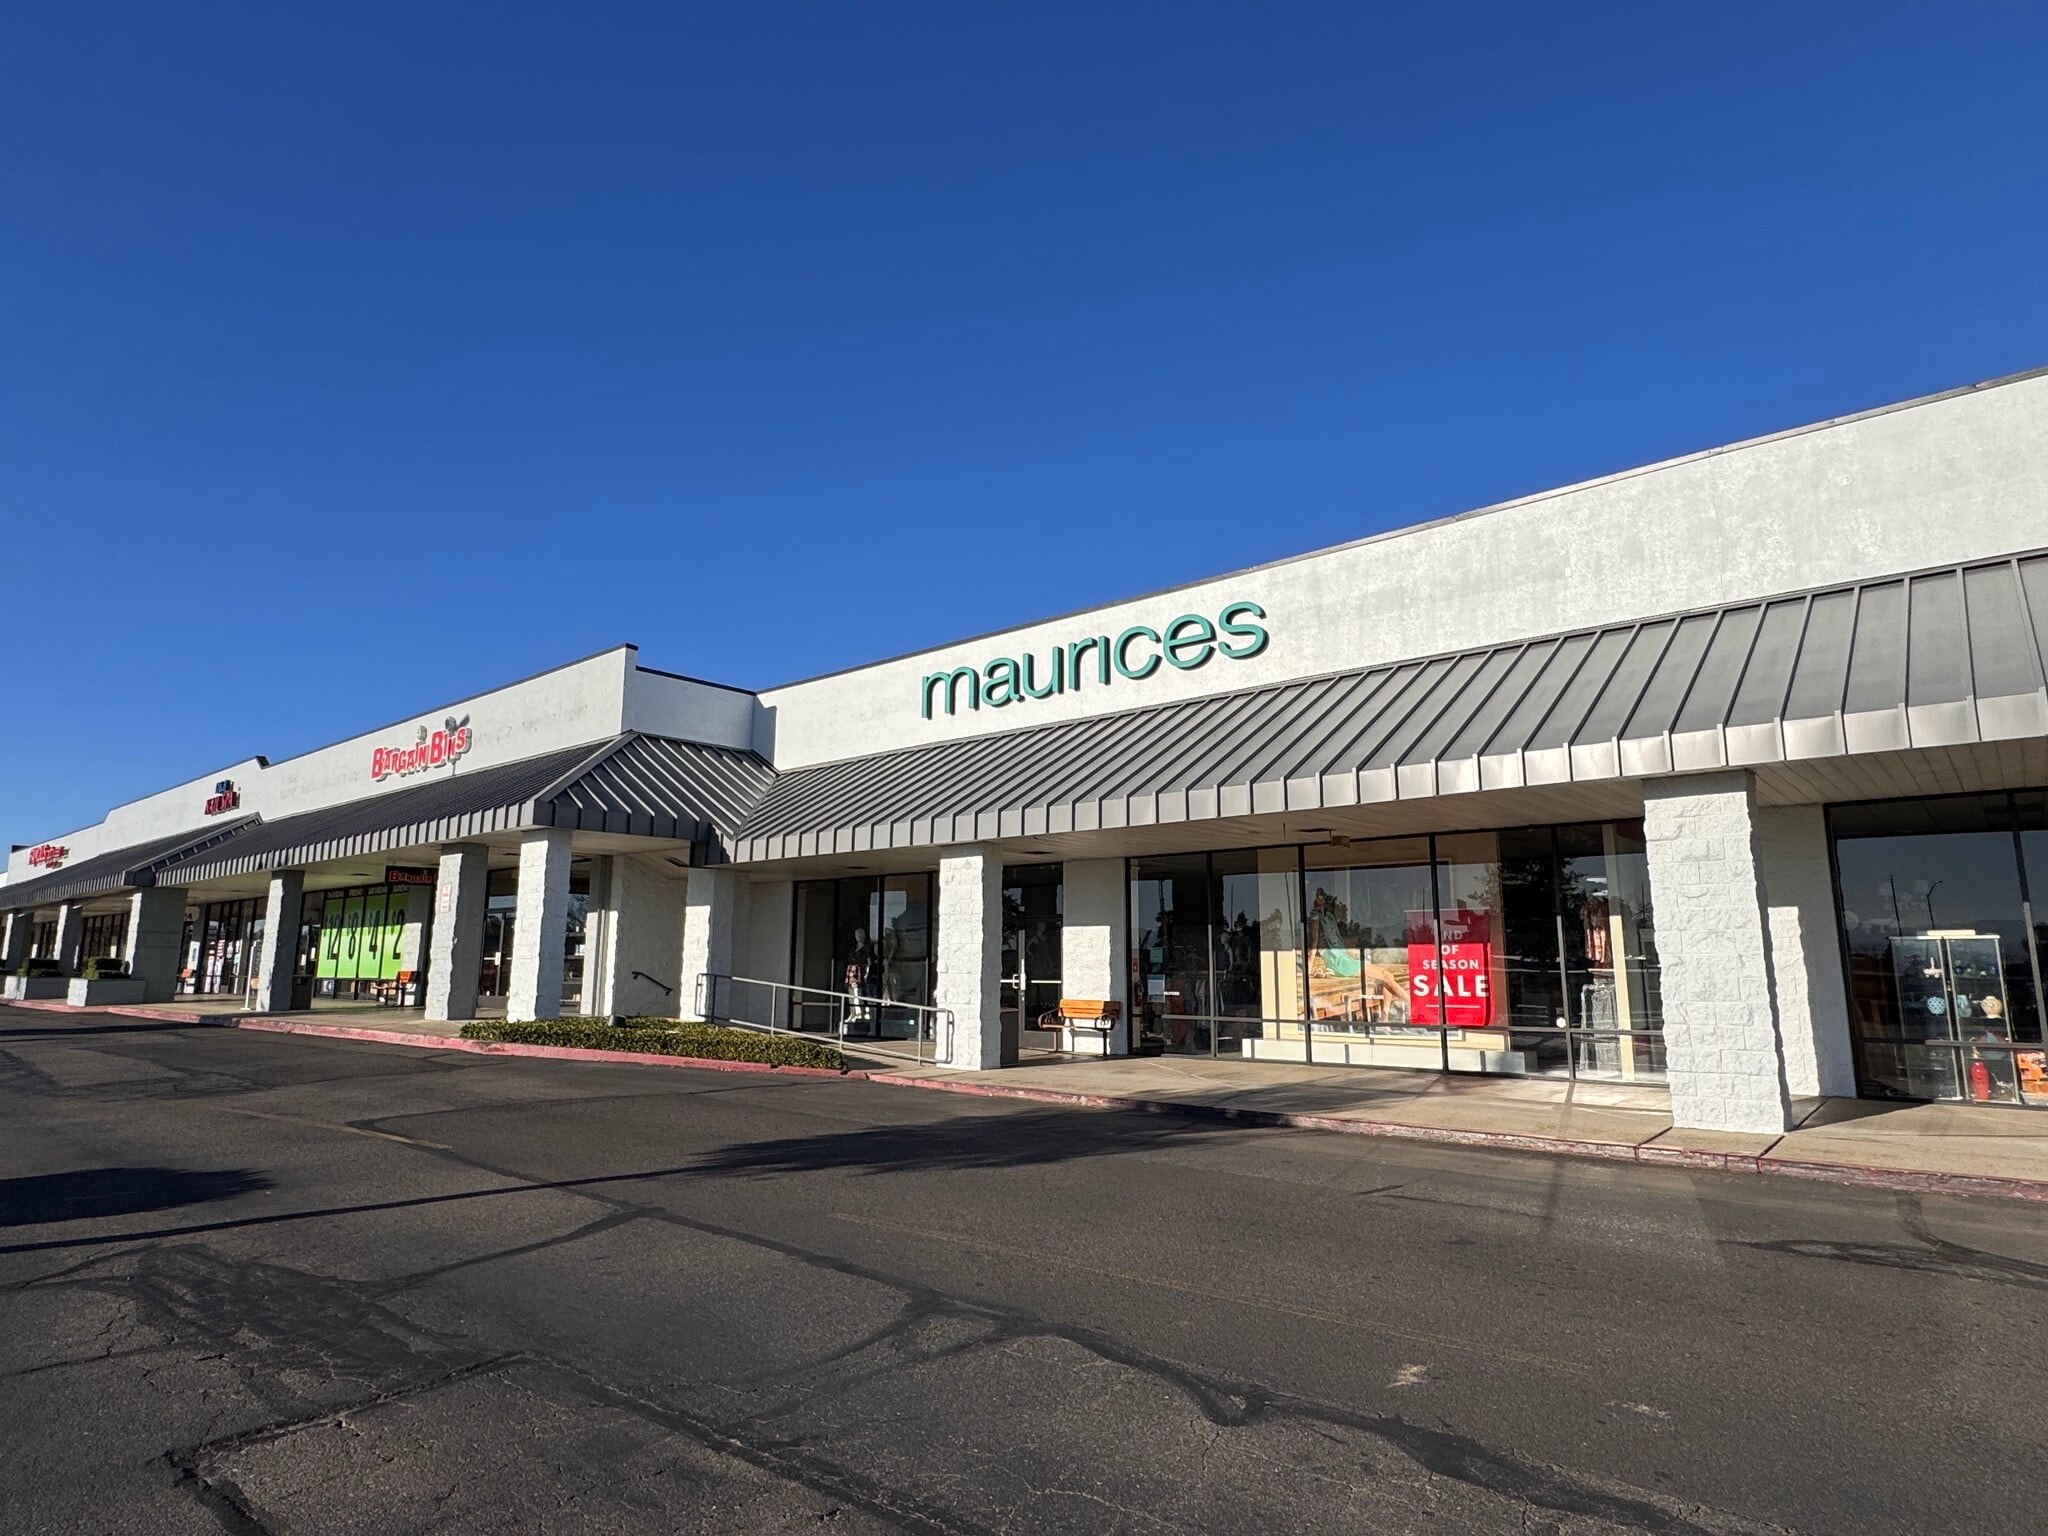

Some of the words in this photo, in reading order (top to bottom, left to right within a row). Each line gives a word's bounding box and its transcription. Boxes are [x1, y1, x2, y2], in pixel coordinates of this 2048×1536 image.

[921, 601, 1268, 719] maurices
[1438, 930, 1463, 940] ND
[1441, 945, 1459, 955] OF
[1422, 960, 1479, 970] SEASON
[1413, 975, 1489, 997] SALE
